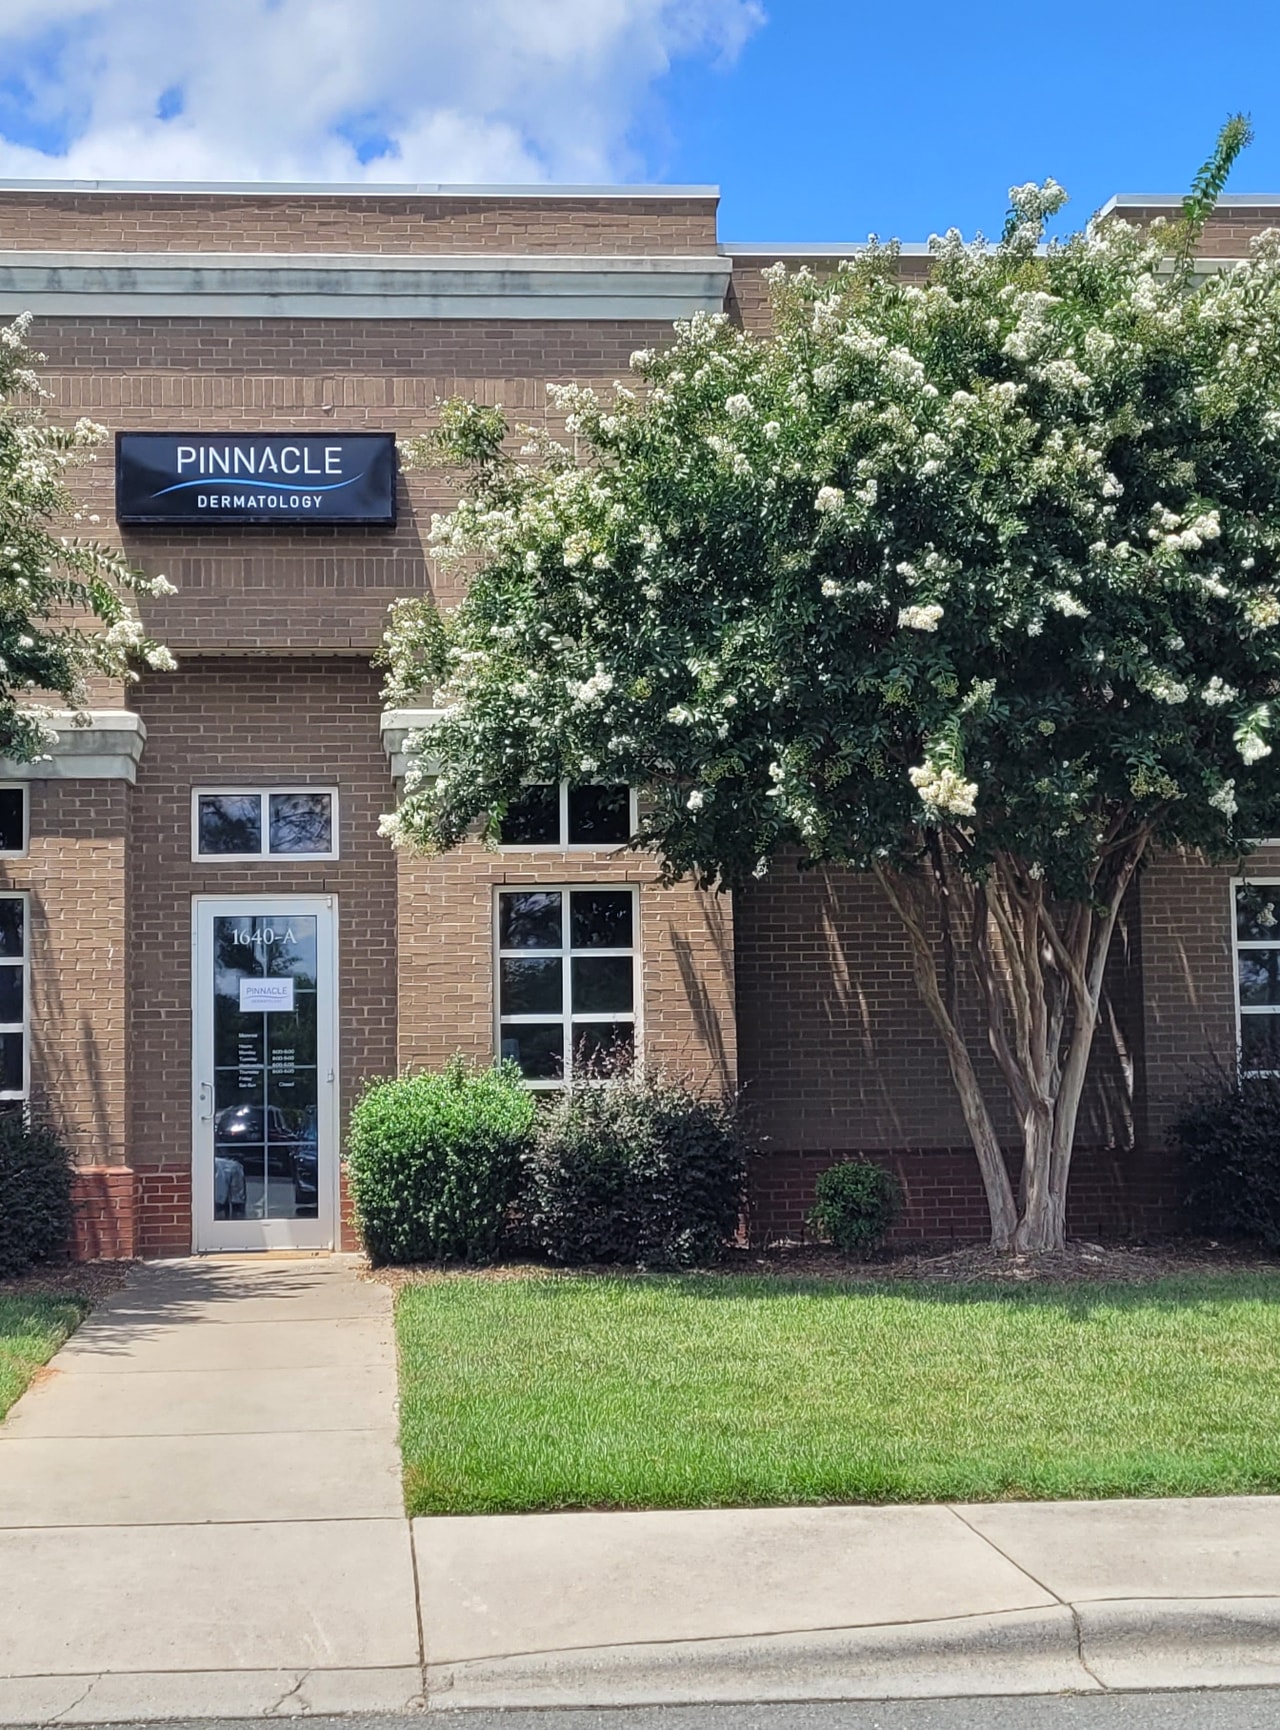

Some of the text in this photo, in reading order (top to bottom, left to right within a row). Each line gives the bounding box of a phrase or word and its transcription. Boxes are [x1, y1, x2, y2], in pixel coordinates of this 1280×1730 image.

[176, 446, 343, 474] PINNACLE
[197, 495, 322, 508] DERMATOLOGY
[231, 928, 298, 945] 1640-A
[246, 986, 288, 995] PINNACLE
